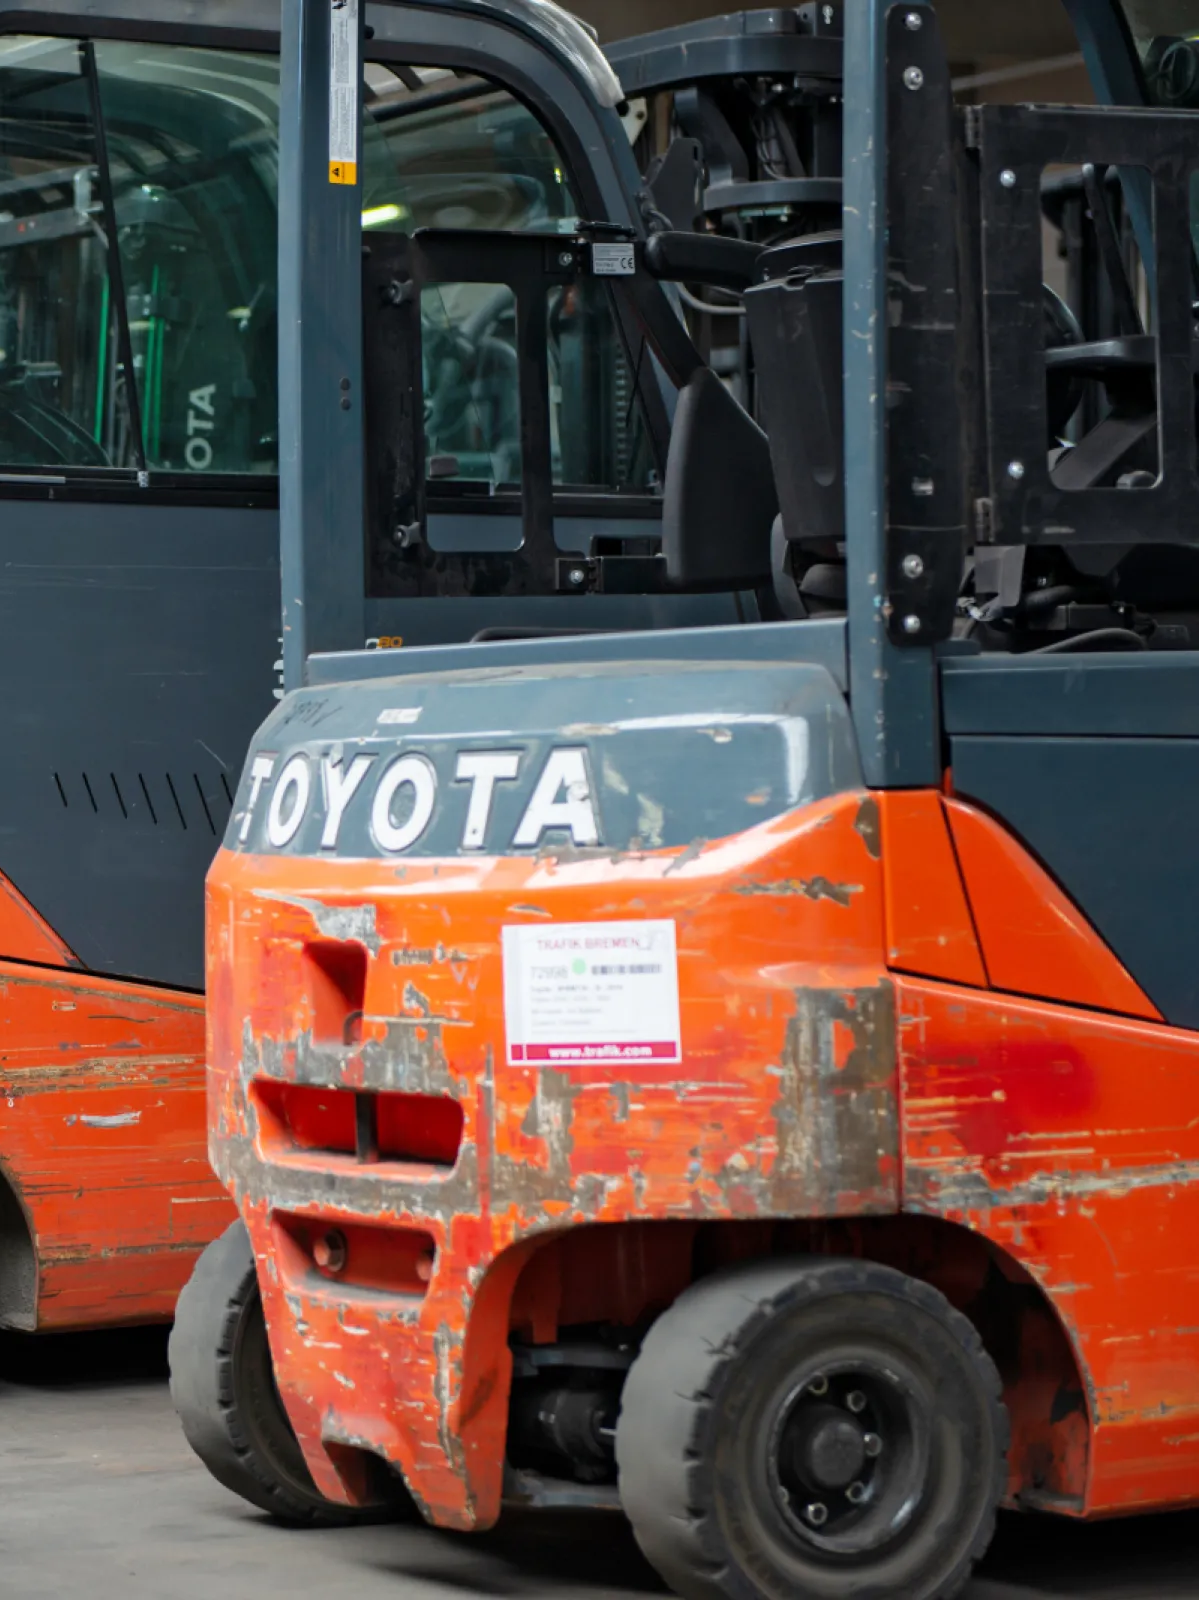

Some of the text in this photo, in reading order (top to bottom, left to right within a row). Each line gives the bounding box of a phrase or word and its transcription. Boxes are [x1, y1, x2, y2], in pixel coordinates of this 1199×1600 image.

[184, 383, 216, 470] OTA
[238, 744, 603, 852] TOYOTA
[537, 936, 640, 951] TRAFIK BREMEN
[547, 1044, 653, 1058] www.trafik.com
